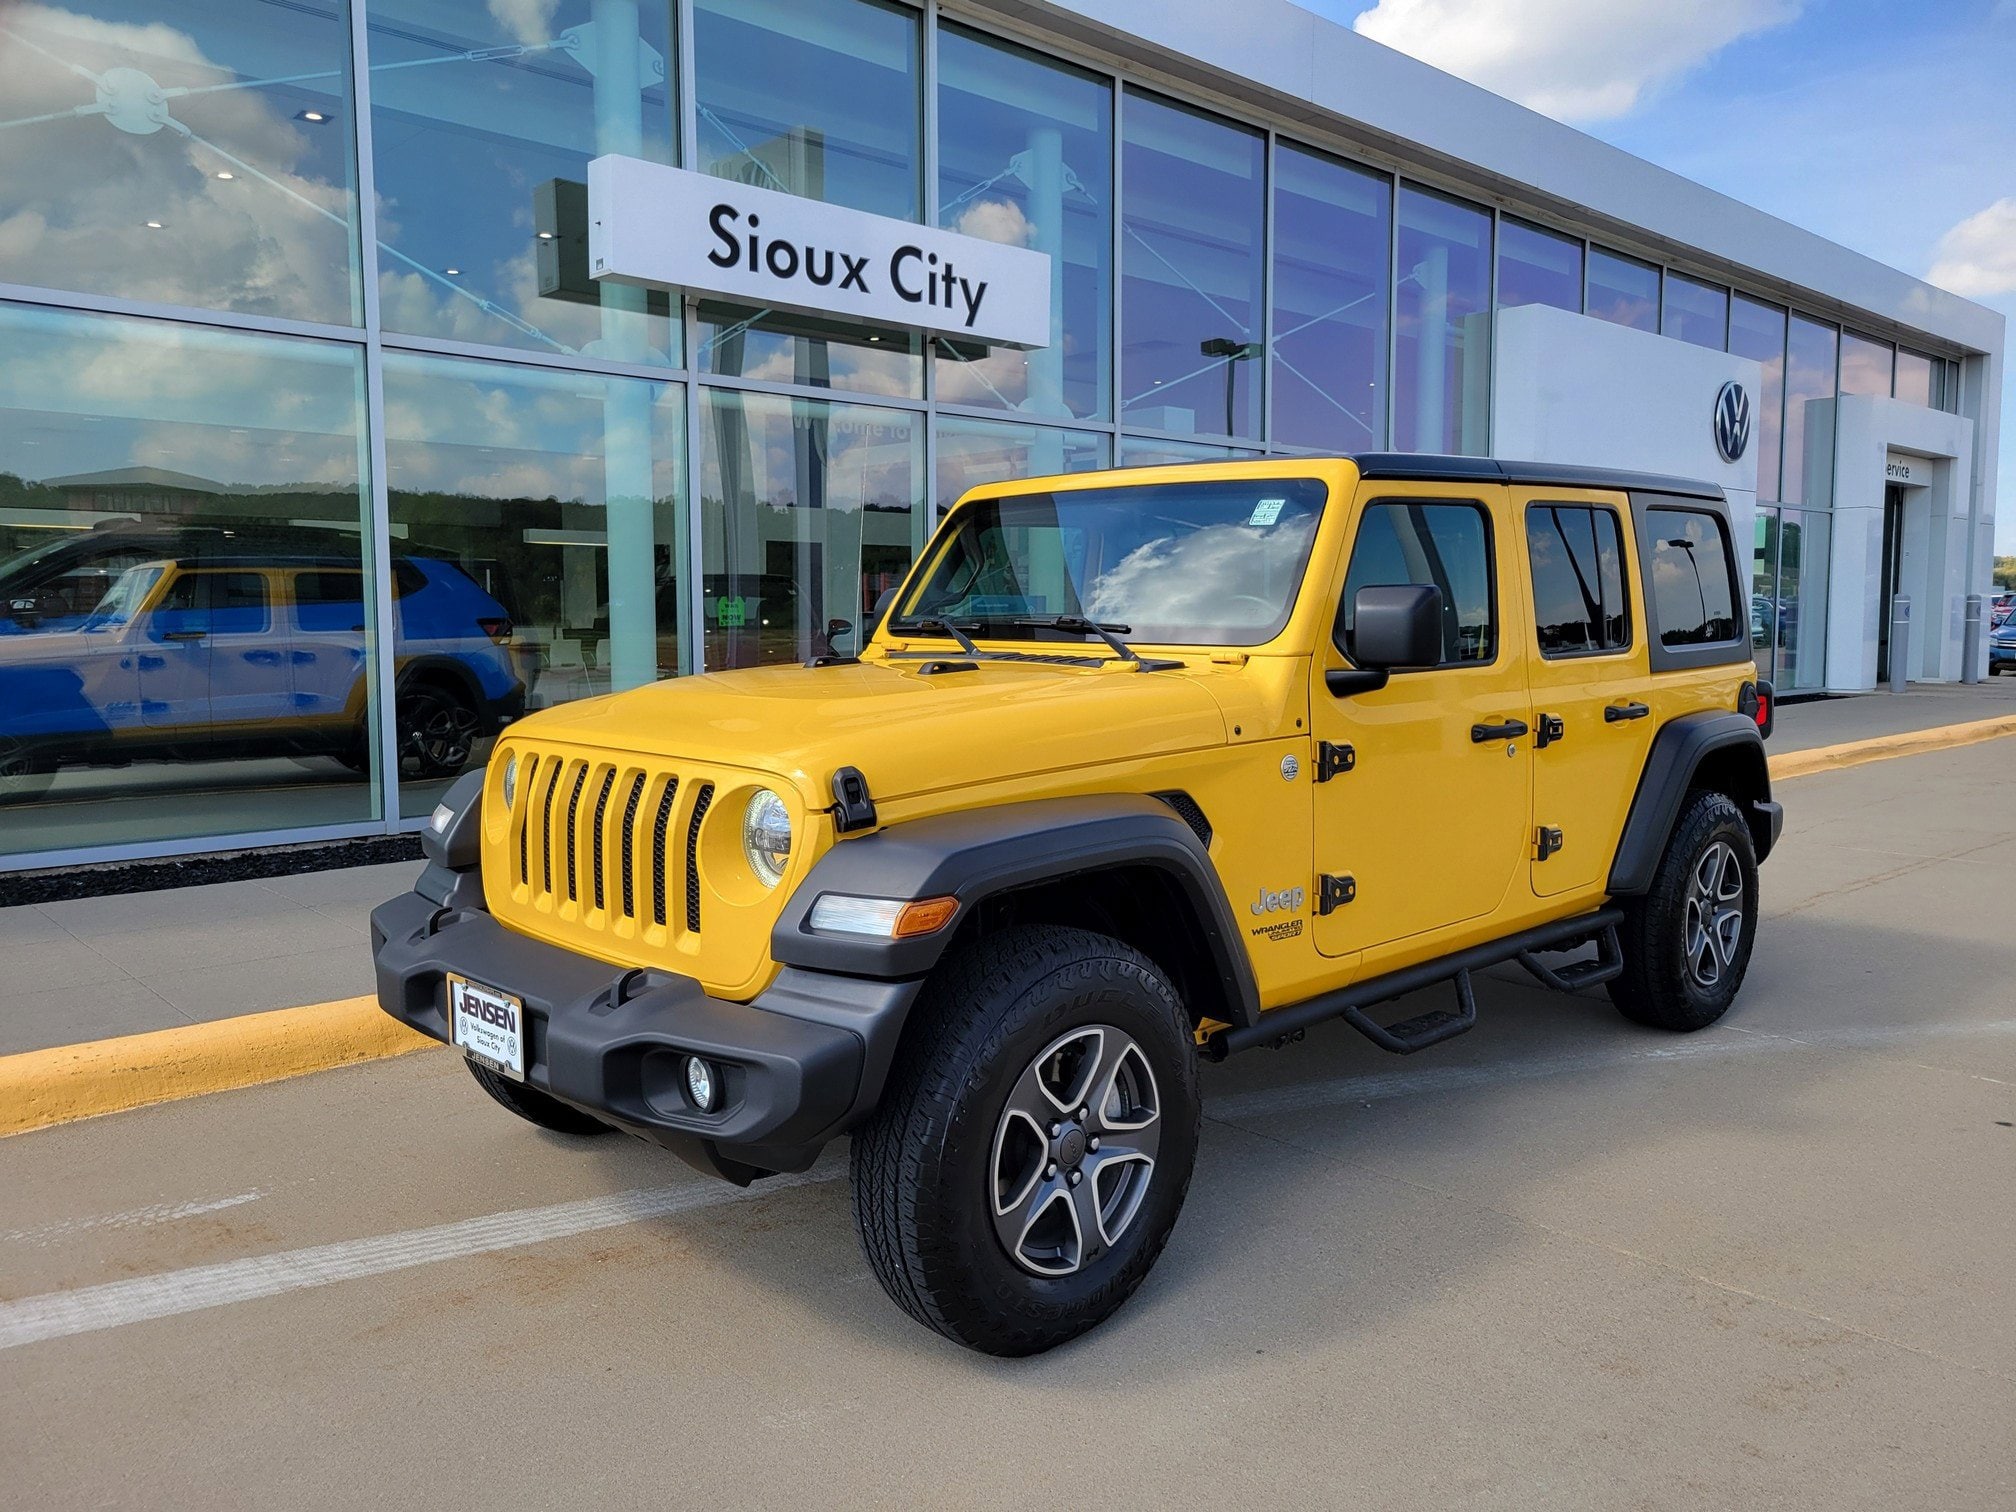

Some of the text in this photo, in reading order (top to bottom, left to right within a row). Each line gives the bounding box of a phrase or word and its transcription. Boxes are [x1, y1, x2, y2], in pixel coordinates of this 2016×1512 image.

[707, 203, 988, 327] Sioux City
[1887, 460, 1910, 478] ervice
[1251, 887, 1304, 915] Jeep
[1251, 919, 1303, 936] WRANGLER
[459, 992, 516, 1034] JENSEN
[470, 1022, 506, 1043] Volkswagen of
[476, 1036, 501, 1054] Sioux City
[471, 1052, 500, 1070] JENSEN
